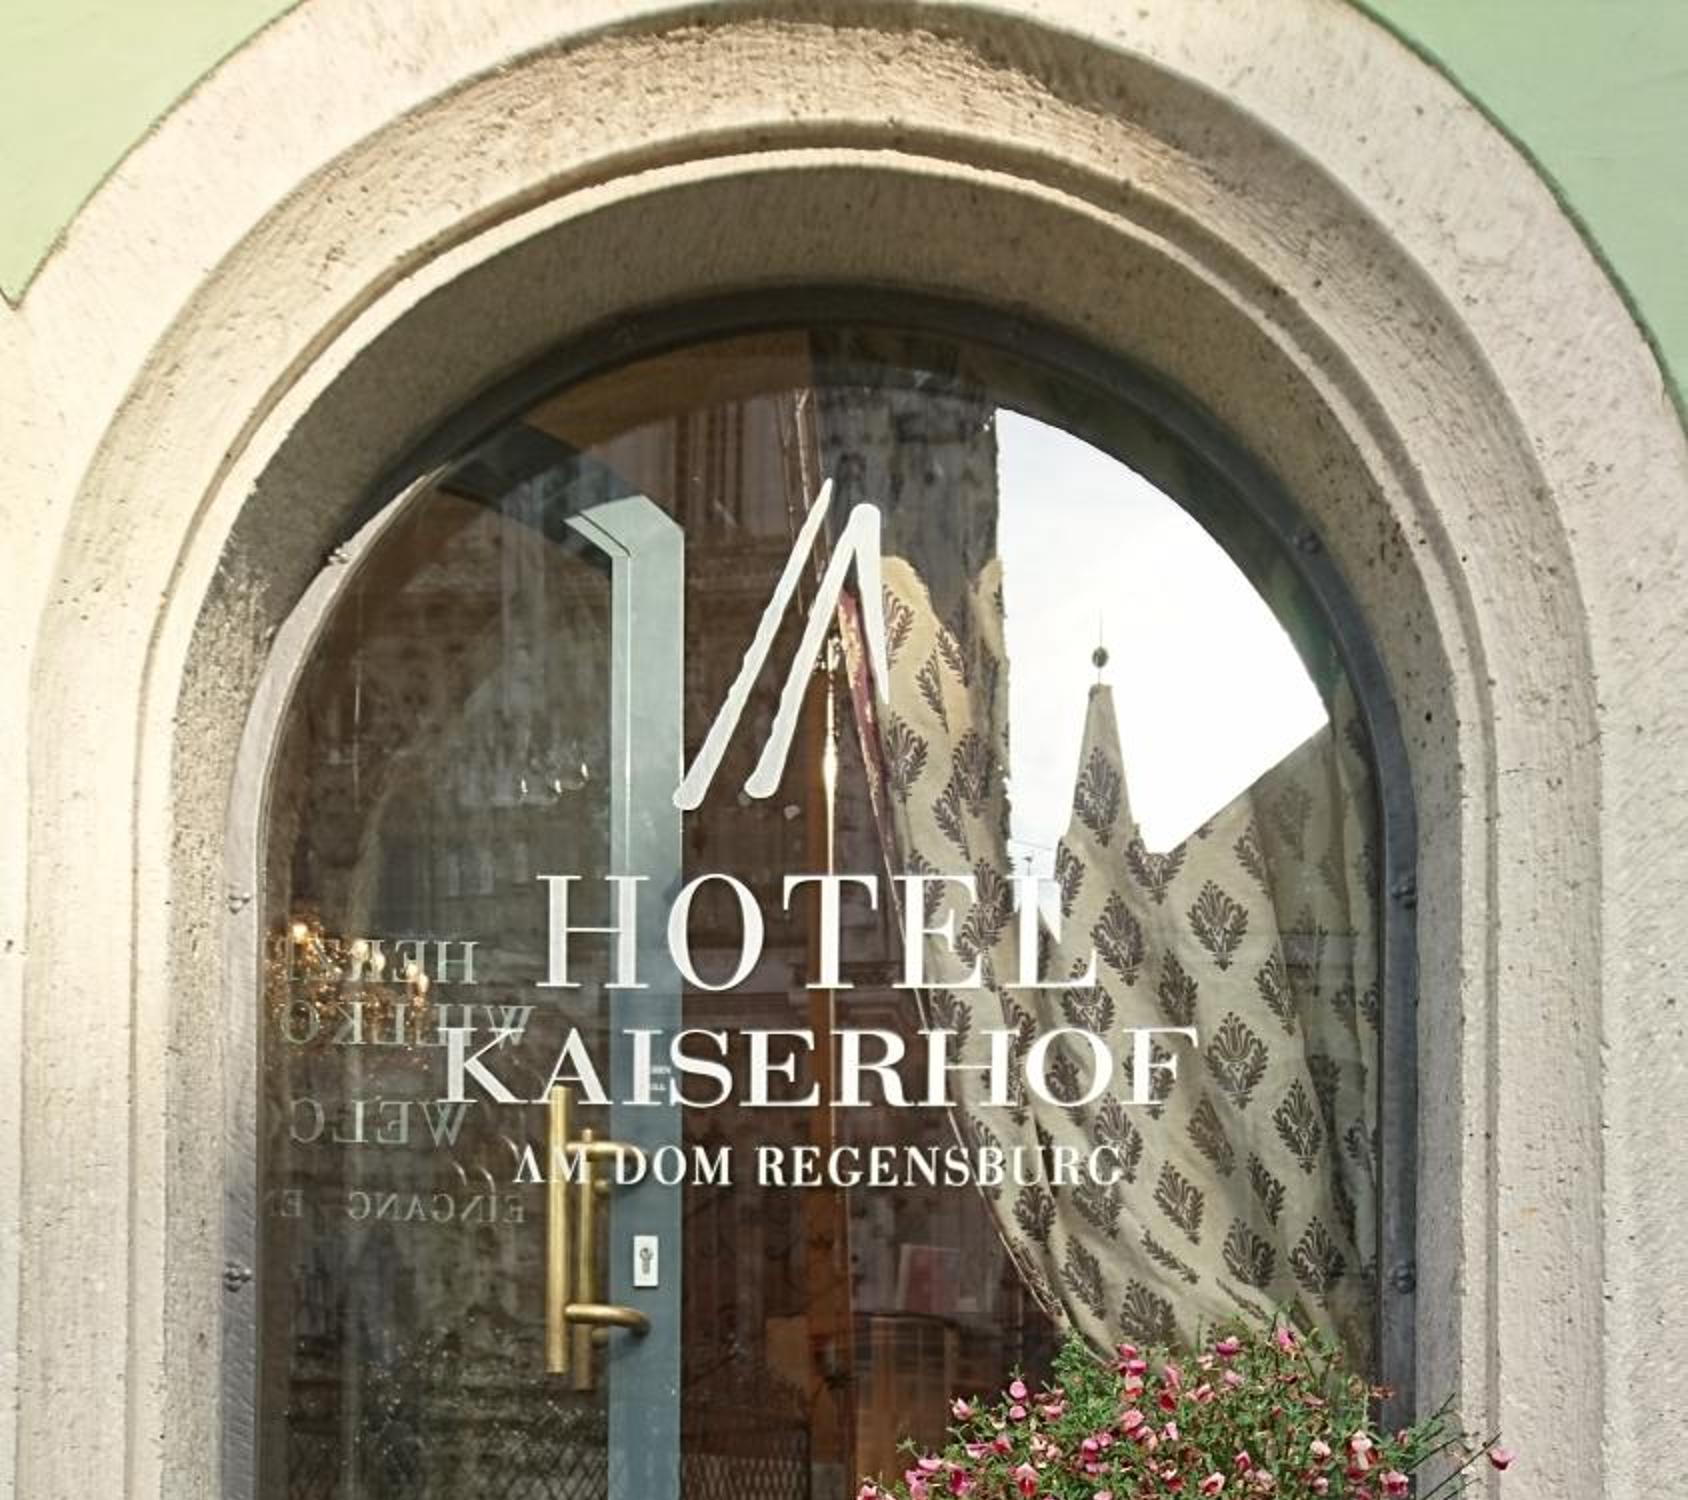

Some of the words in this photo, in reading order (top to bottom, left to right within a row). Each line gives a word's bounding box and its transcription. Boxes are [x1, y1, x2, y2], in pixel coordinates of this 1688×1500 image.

[537, 873, 1100, 991] HOTEL
[438, 1027, 1199, 1107] KAISERHOF
[513, 1144, 591, 1184] AM
[614, 1144, 732, 1186] DOM
[757, 1143, 1125, 1187] REGENSBURG
